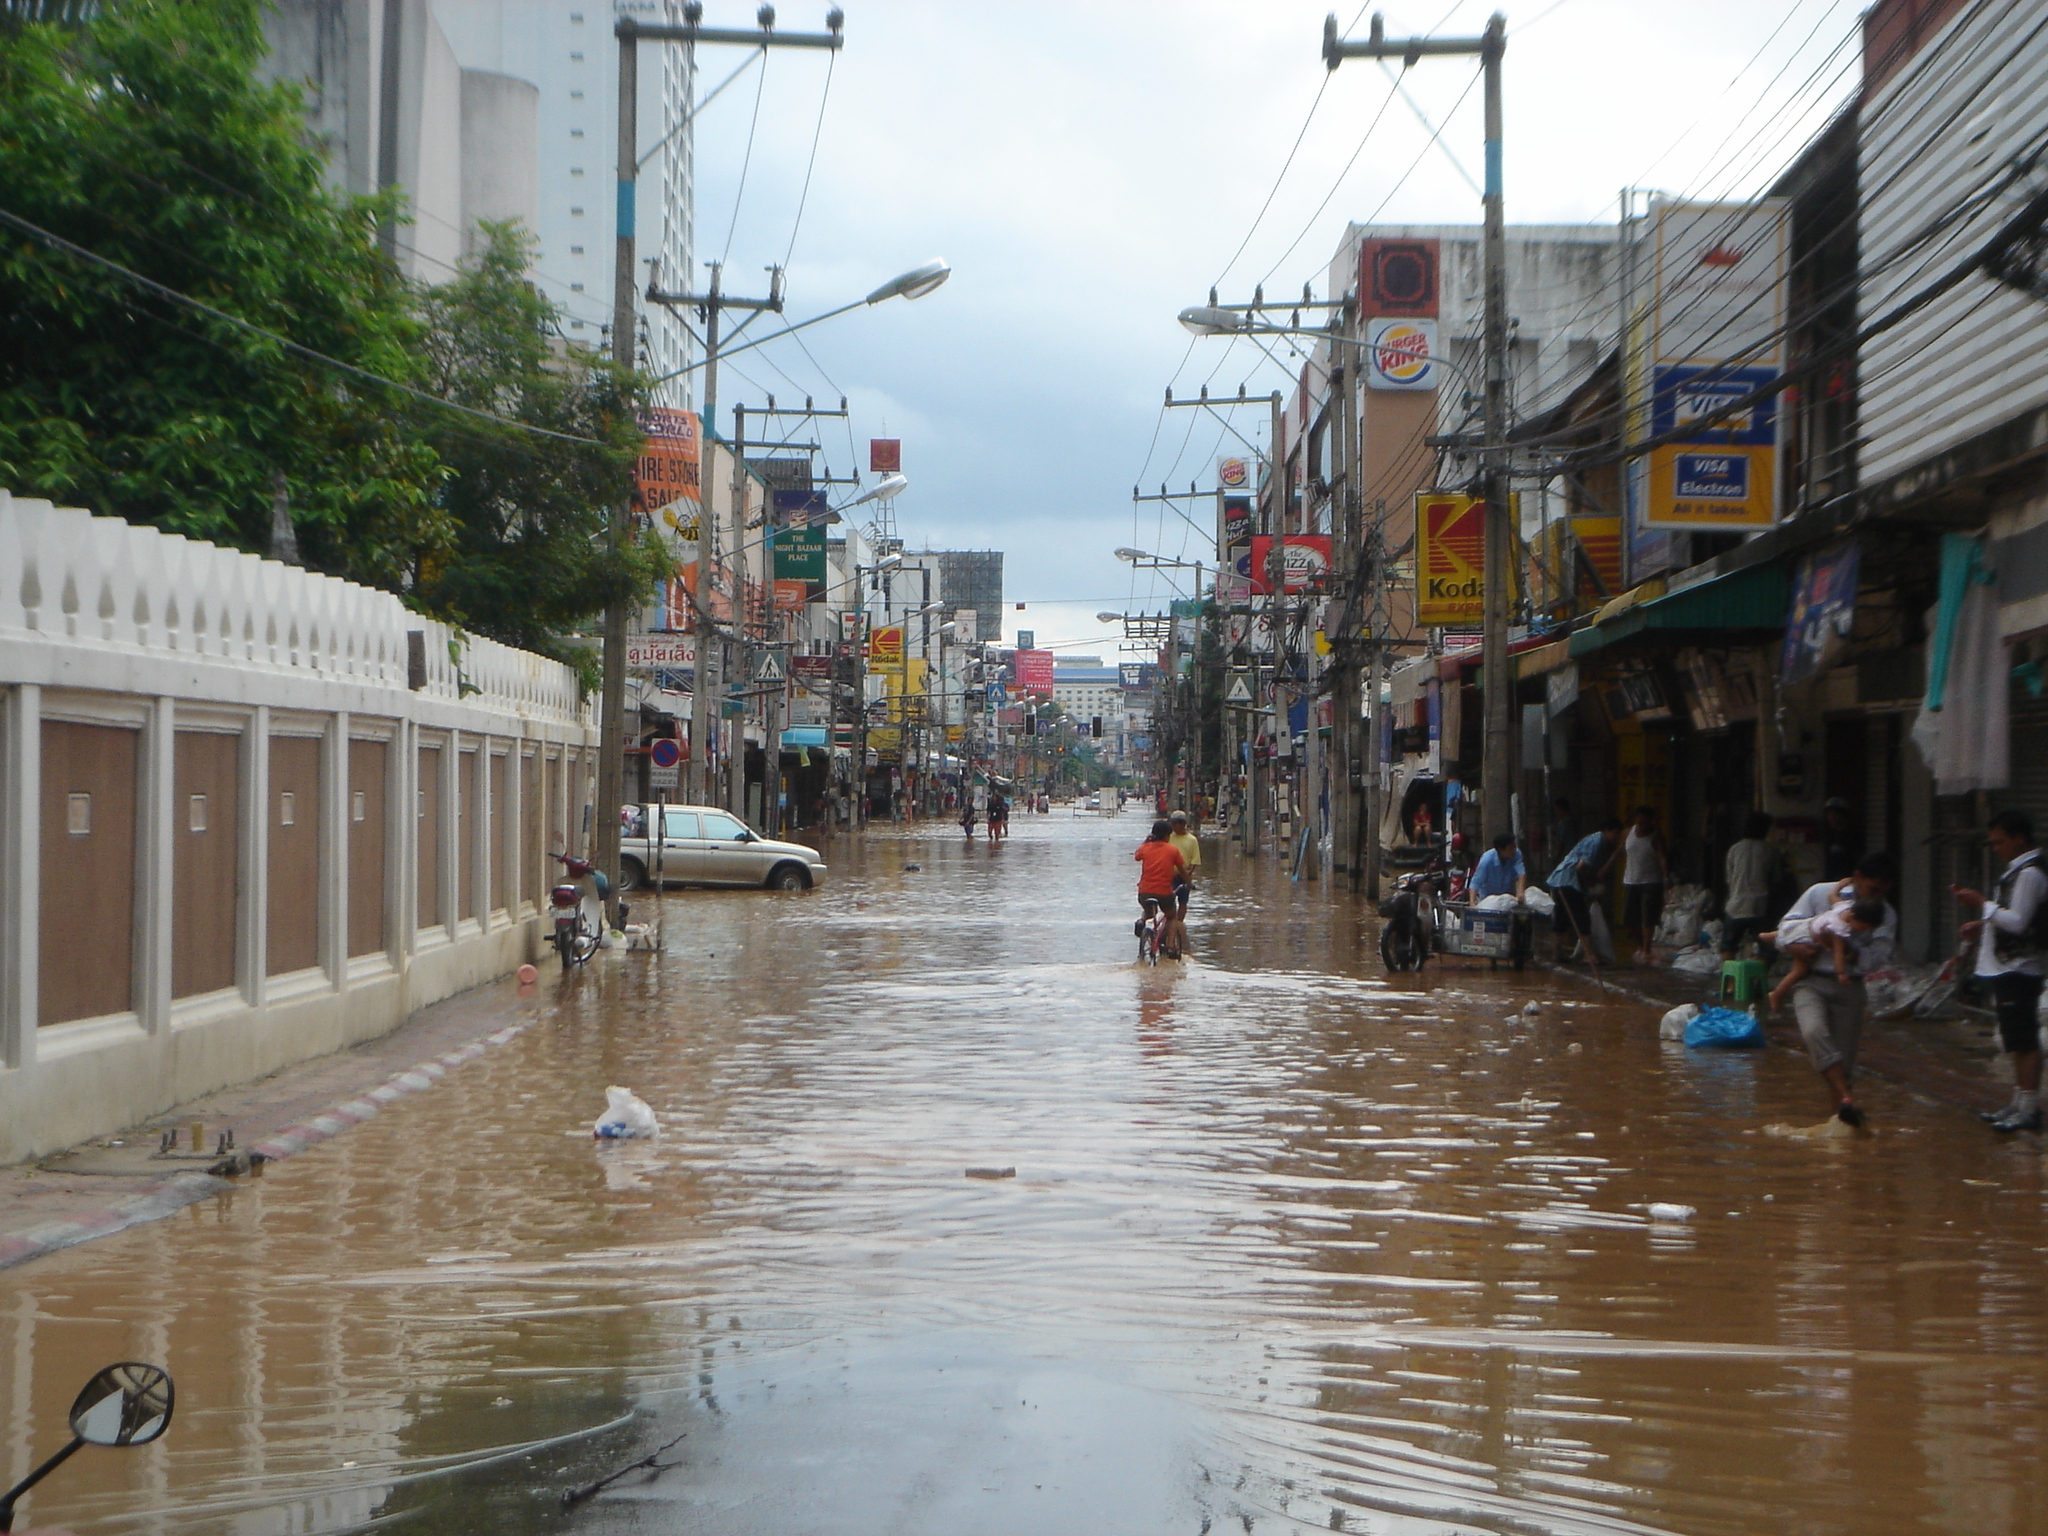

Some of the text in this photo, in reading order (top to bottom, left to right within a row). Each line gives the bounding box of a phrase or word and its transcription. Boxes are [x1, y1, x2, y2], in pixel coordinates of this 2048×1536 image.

[1381, 344, 1429, 373] KING
[641, 455, 700, 486] IRE STORE
[1695, 459, 1729, 473] VISA
[1681, 481, 1743, 495] Electron
[1226, 518, 1250, 532] izza
[792, 534, 805, 542] THE
[774, 544, 822, 552] NIGHT BAZAAR
[788, 553, 809, 562] PLACE
[1428, 577, 1485, 600] Koda
[870, 654, 900, 664] Kodak
